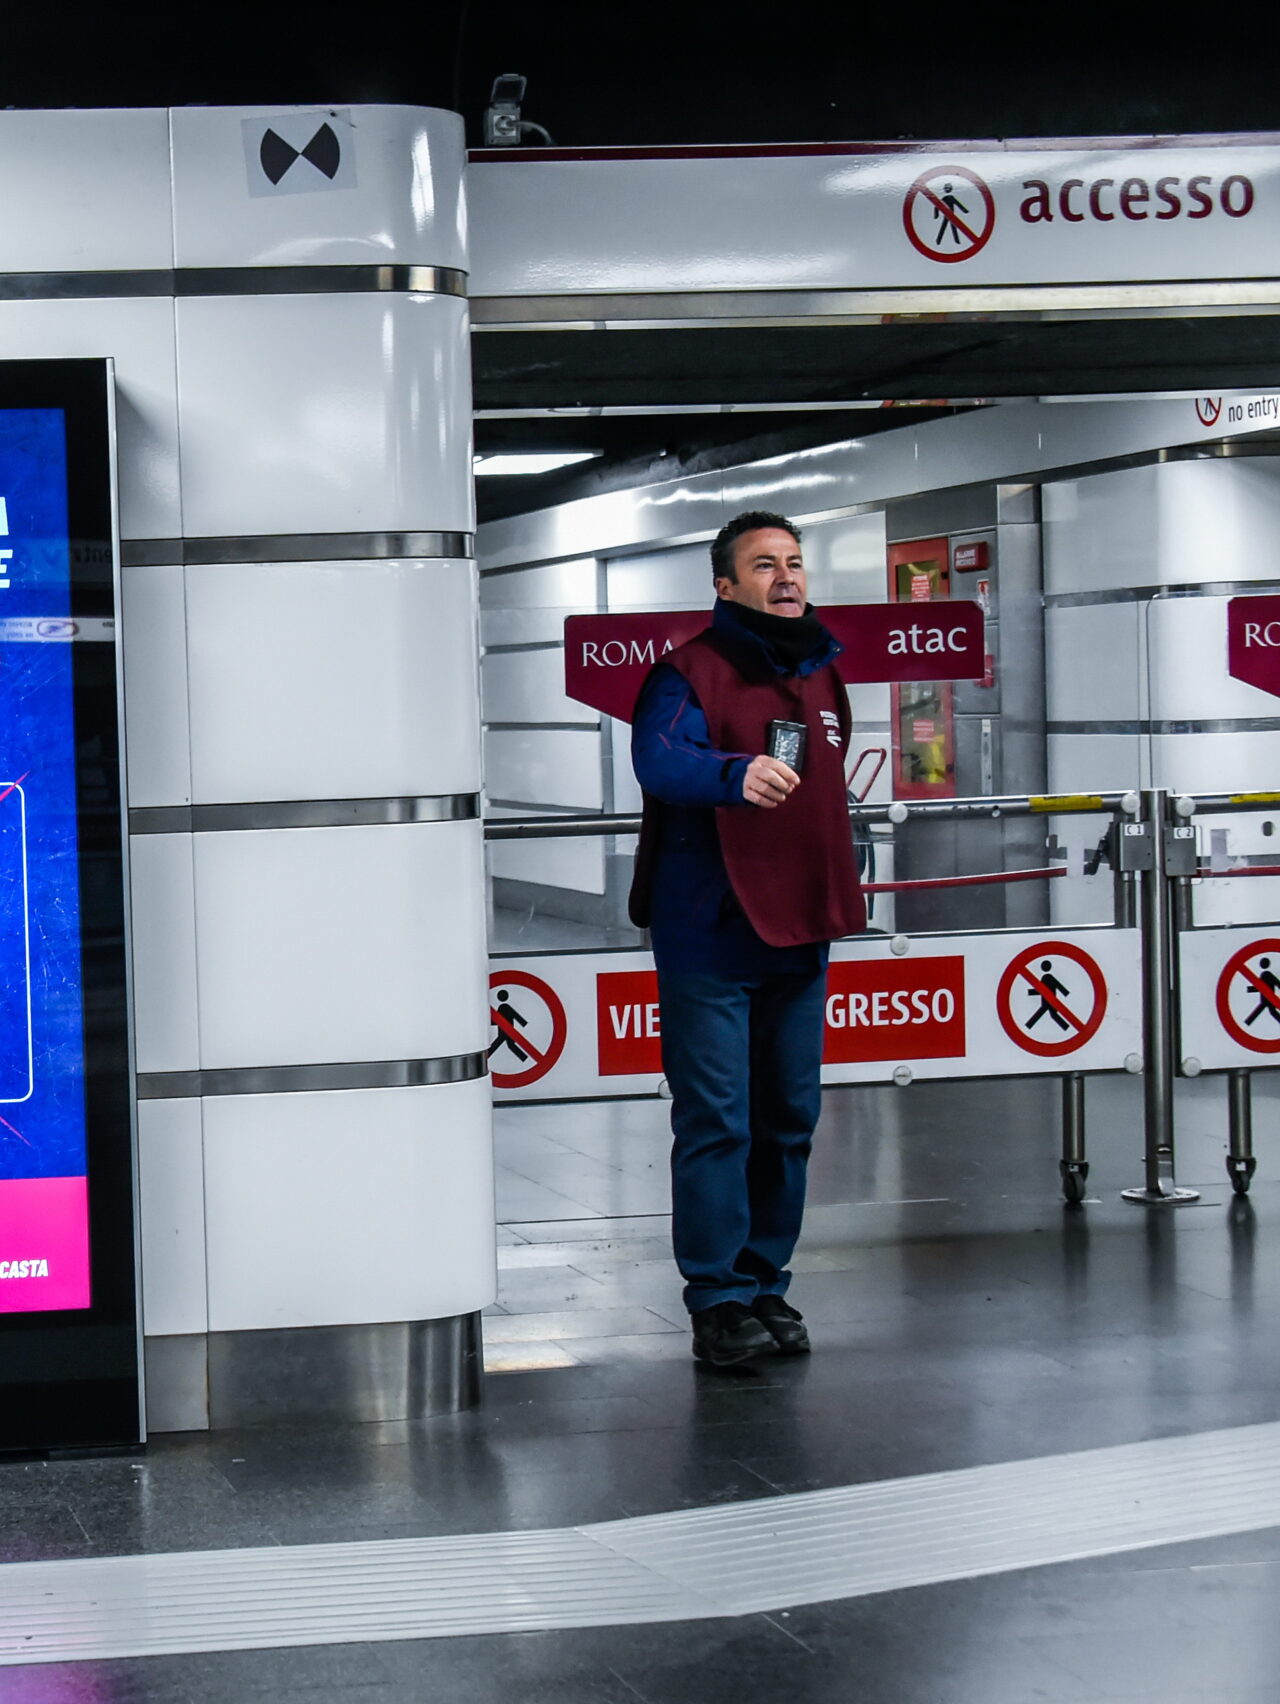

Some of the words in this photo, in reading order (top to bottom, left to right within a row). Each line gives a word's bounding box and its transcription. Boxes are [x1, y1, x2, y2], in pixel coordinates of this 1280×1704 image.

[1019, 174, 1254, 223] accesso
[1228, 405, 1243, 423] no
[1247, 396, 1279, 419] entry
[887, 624, 967, 655] atac
[1126, 825, 1132, 835] C
[1136, 825, 1142, 835] 1
[1176, 828, 1182, 838] C
[1186, 828, 1192, 837] 2
